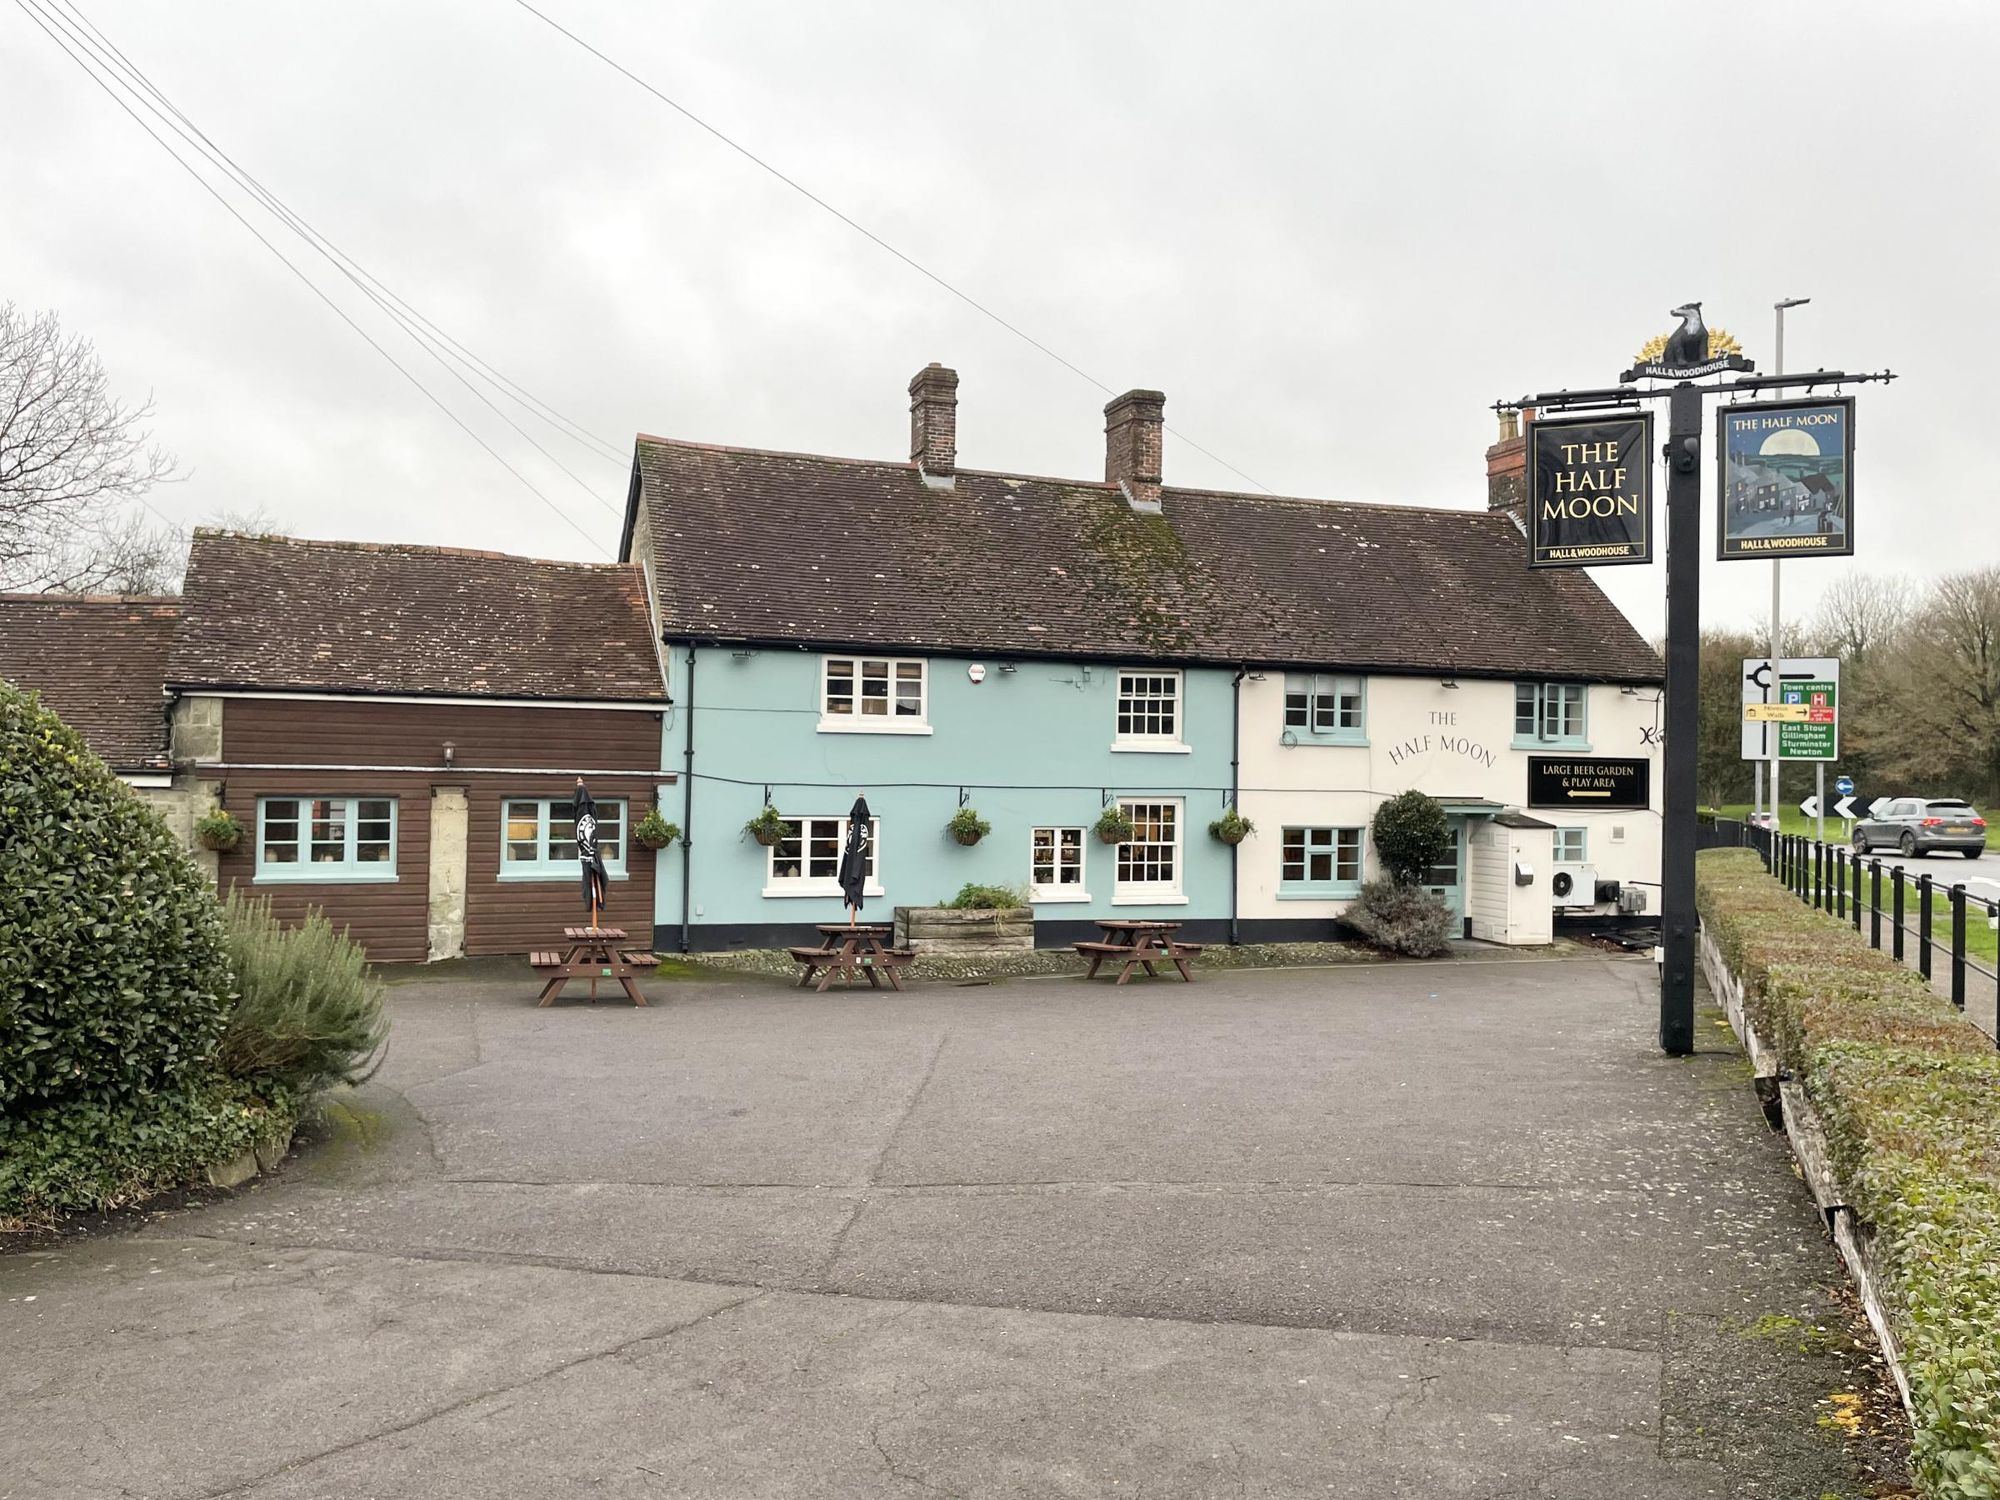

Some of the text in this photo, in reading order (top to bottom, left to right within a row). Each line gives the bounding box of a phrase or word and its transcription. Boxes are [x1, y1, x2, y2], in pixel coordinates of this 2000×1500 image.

[1733, 413, 1838, 431] THE HALF MOON
[1561, 441, 1619, 465] THE
[1555, 467, 1627, 493] HALF
[1542, 494, 1639, 520] MOON
[1788, 694, 1824, 705] P H
[1428, 711, 1457, 726] THE
[1782, 732, 1826, 740] Gillingham
[1389, 735, 1497, 768] HALF MOON
[1782, 740, 1831, 748] Sturminster
[1543, 765, 1634, 776] LARGE BEER GARDEN
[1562, 778, 1616, 787] & PLAY AREA
